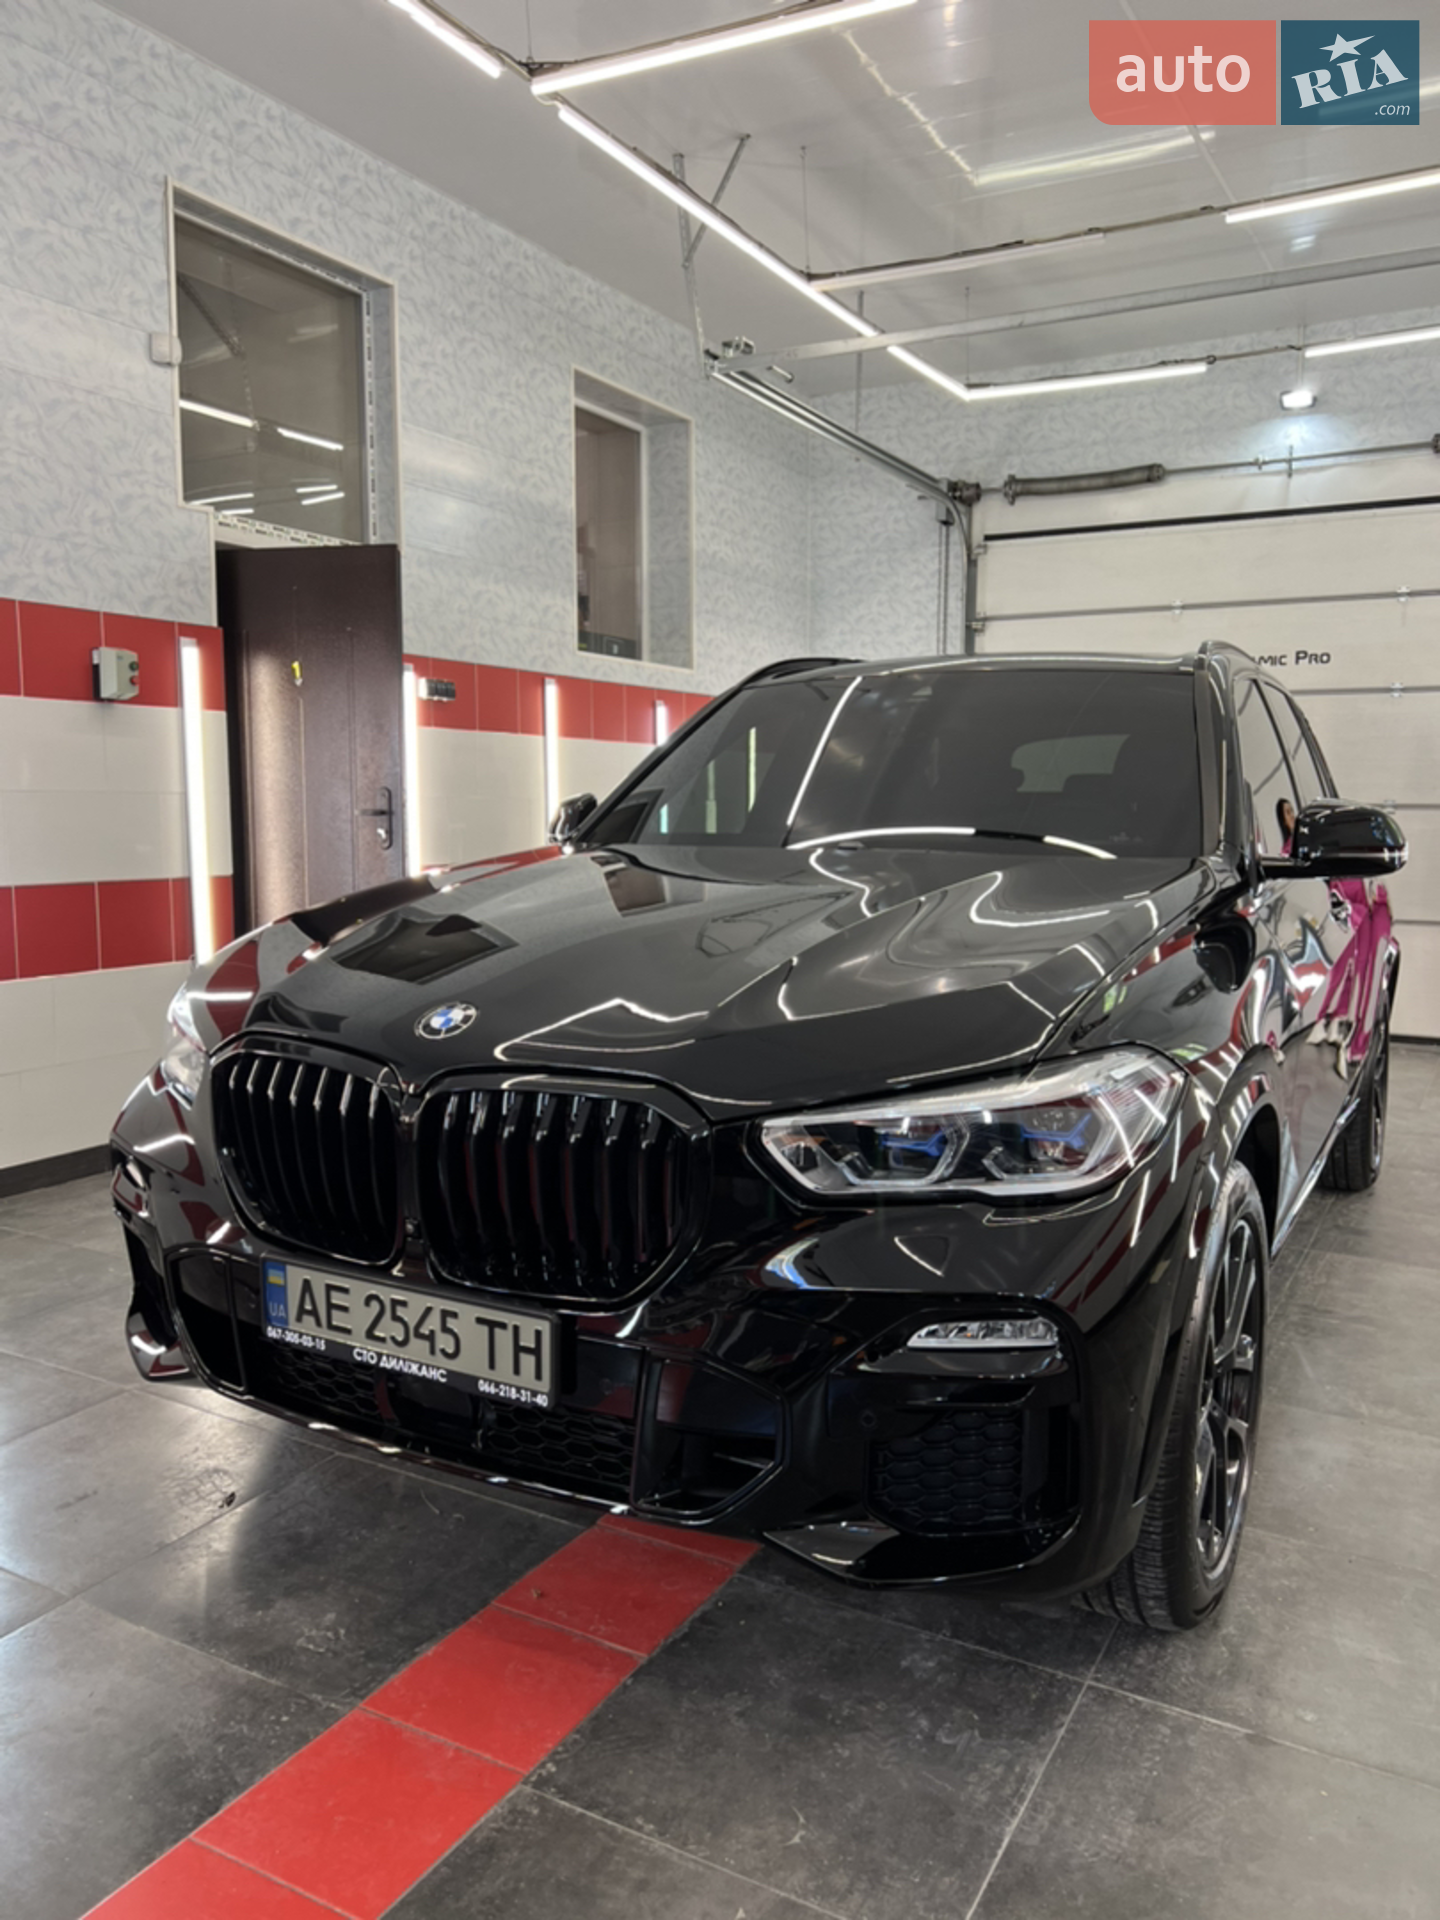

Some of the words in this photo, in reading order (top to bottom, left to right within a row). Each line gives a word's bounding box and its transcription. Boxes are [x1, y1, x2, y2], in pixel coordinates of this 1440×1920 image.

[1251, 654, 1288, 667] MIC
[268, 1301, 288, 1320] UA
[294, 1276, 353, 1336] AE
[363, 1292, 462, 1361] 2545
[474, 1315, 543, 1382] TH
[352, 1347, 378, 1365] СТО
[477, 1378, 549, 1408] 066-218-31-40
